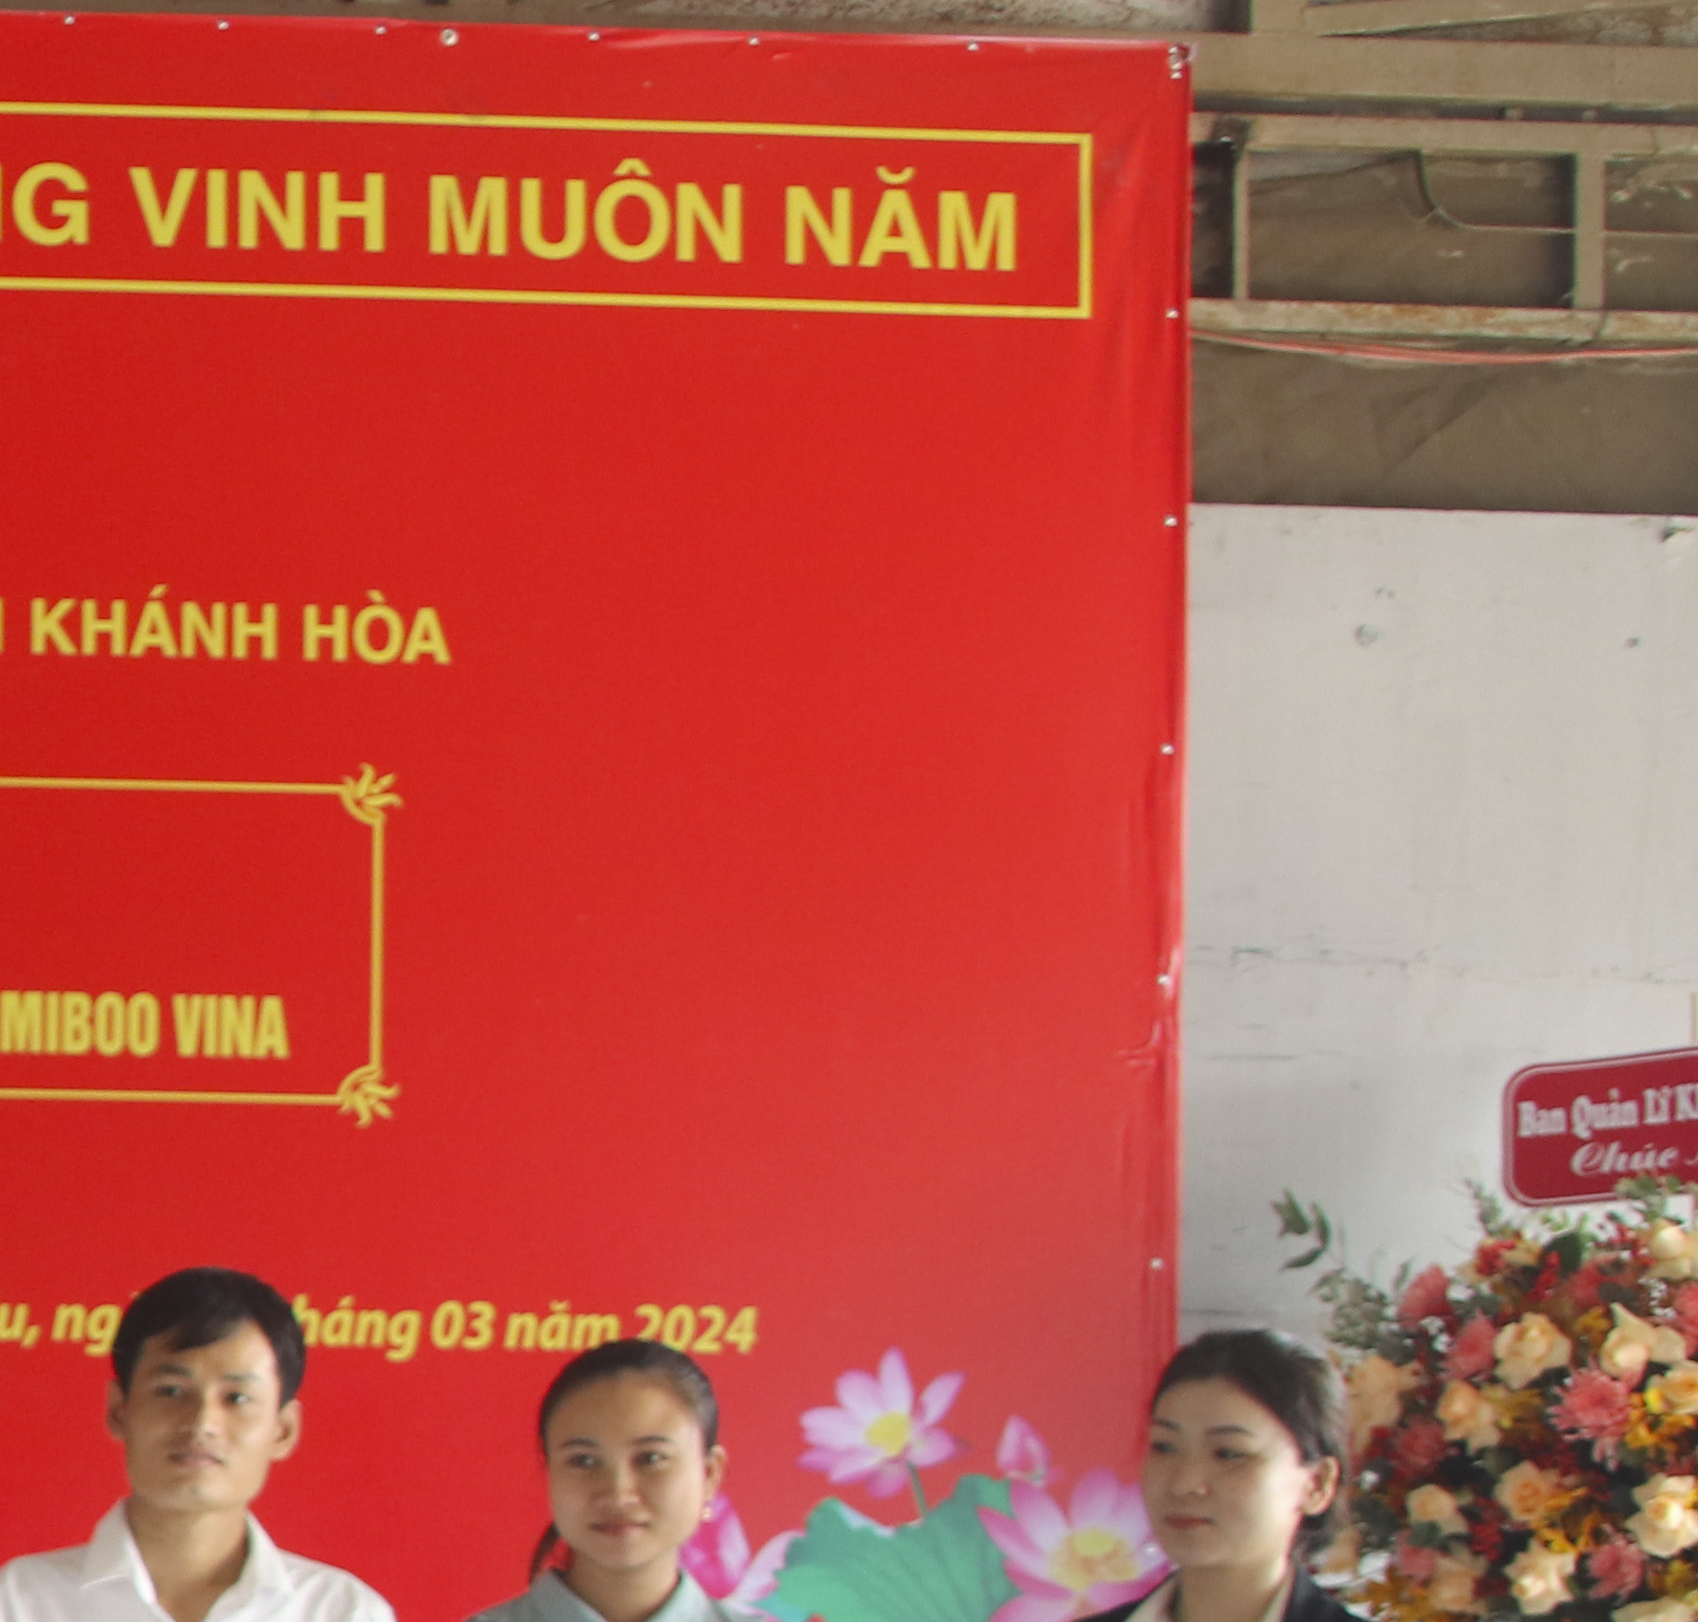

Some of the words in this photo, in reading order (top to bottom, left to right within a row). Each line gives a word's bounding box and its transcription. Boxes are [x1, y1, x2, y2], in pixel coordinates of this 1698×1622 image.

[128, 165, 386, 254] VINH
[428, 156, 744, 264] MUÔN
[784, 165, 1018, 273] NĂM
[30, 583, 278, 661] KHÁNH
[302, 588, 452, 666] HÒA
[171, 992, 290, 1060] VINA
[290, 1293, 422, 1364] háng
[430, 1299, 498, 1351] 03
[504, 1300, 622, 1353] năm
[634, 1302, 759, 1354] 2024
